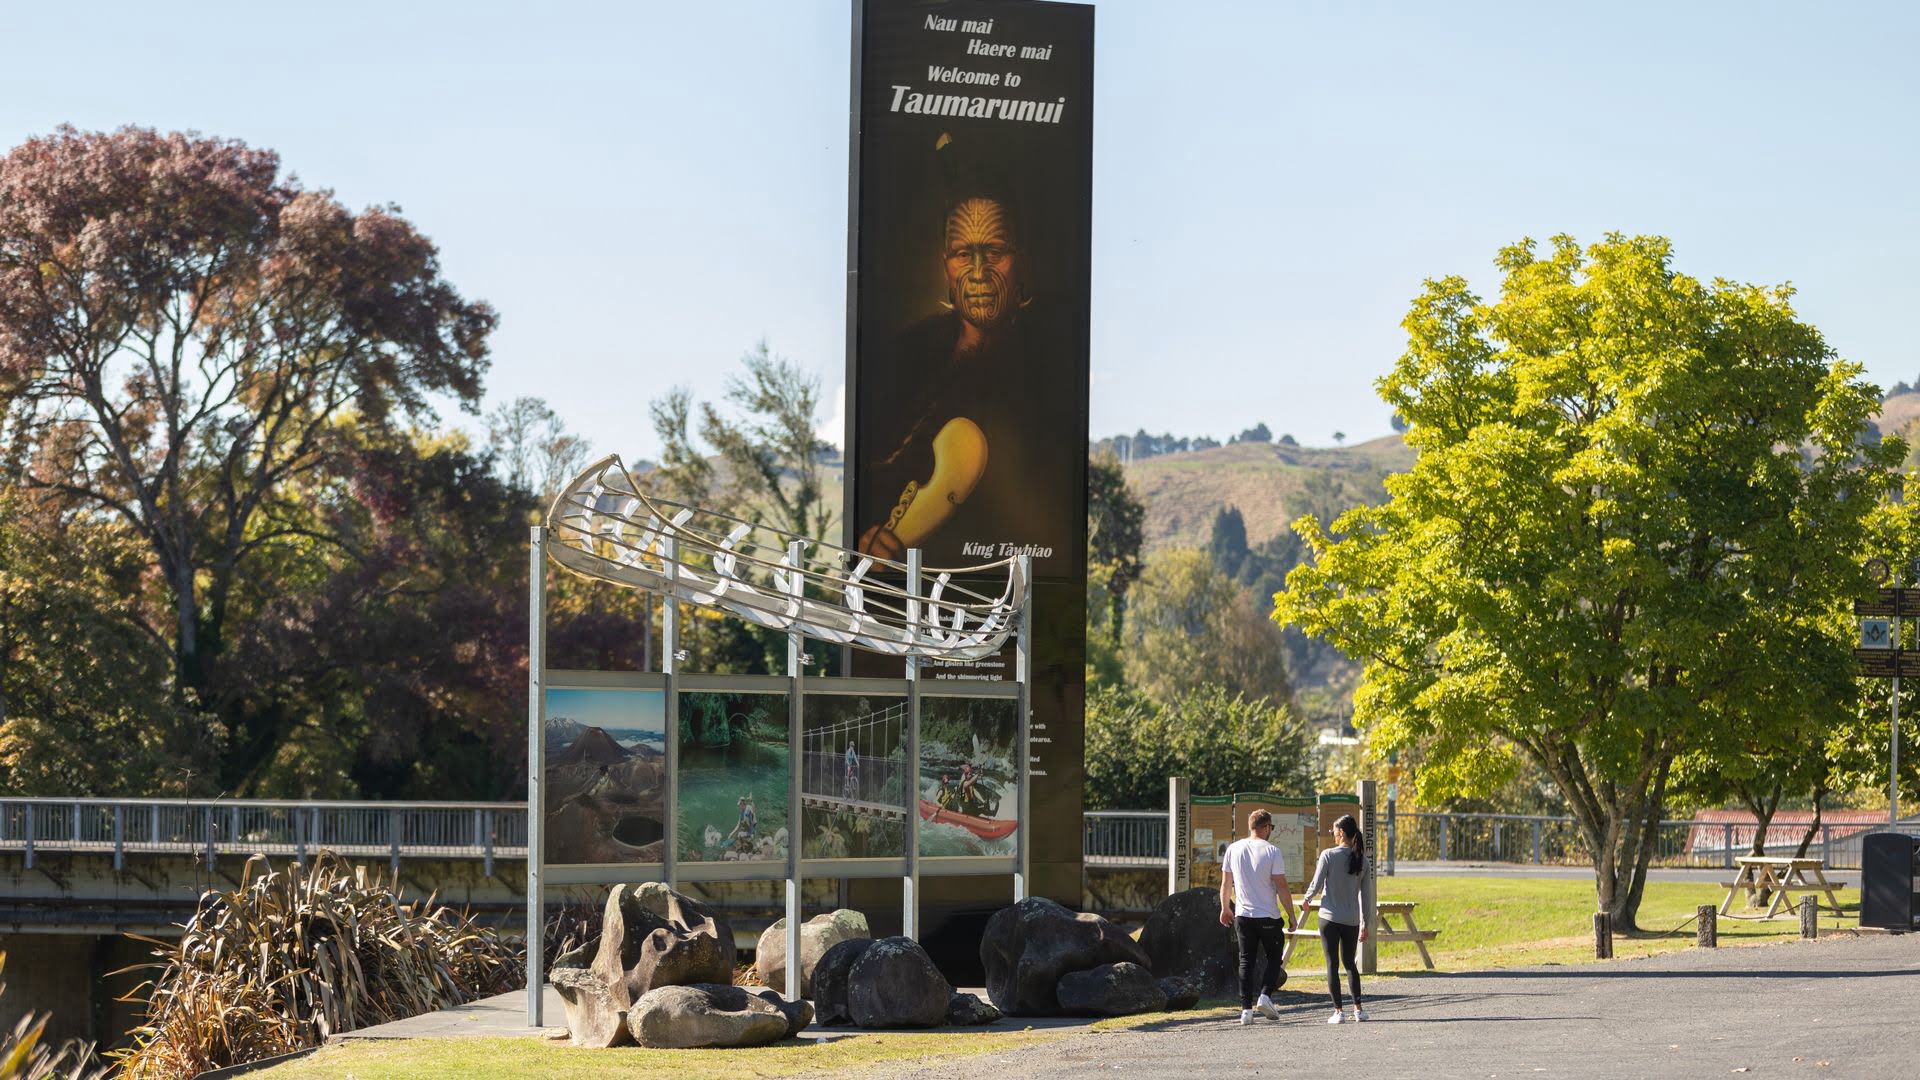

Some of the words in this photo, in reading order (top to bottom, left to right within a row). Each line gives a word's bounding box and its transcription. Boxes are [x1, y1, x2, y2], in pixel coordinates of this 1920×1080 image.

[924, 14, 958, 32] Nau
[961, 19, 994, 34] mai
[967, 39, 1016, 58] Haere
[1020, 45, 1053, 60] mai
[928, 65, 1000, 86] Welcome
[1004, 72, 1022, 87] to
[890, 85, 1066, 124] Taumarunui
[962, 542, 995, 559] King
[1178, 803, 1187, 850] HERITAGE
[1365, 804, 1374, 852] HERITAGE
[1177, 854, 1186, 881] TRAIL
